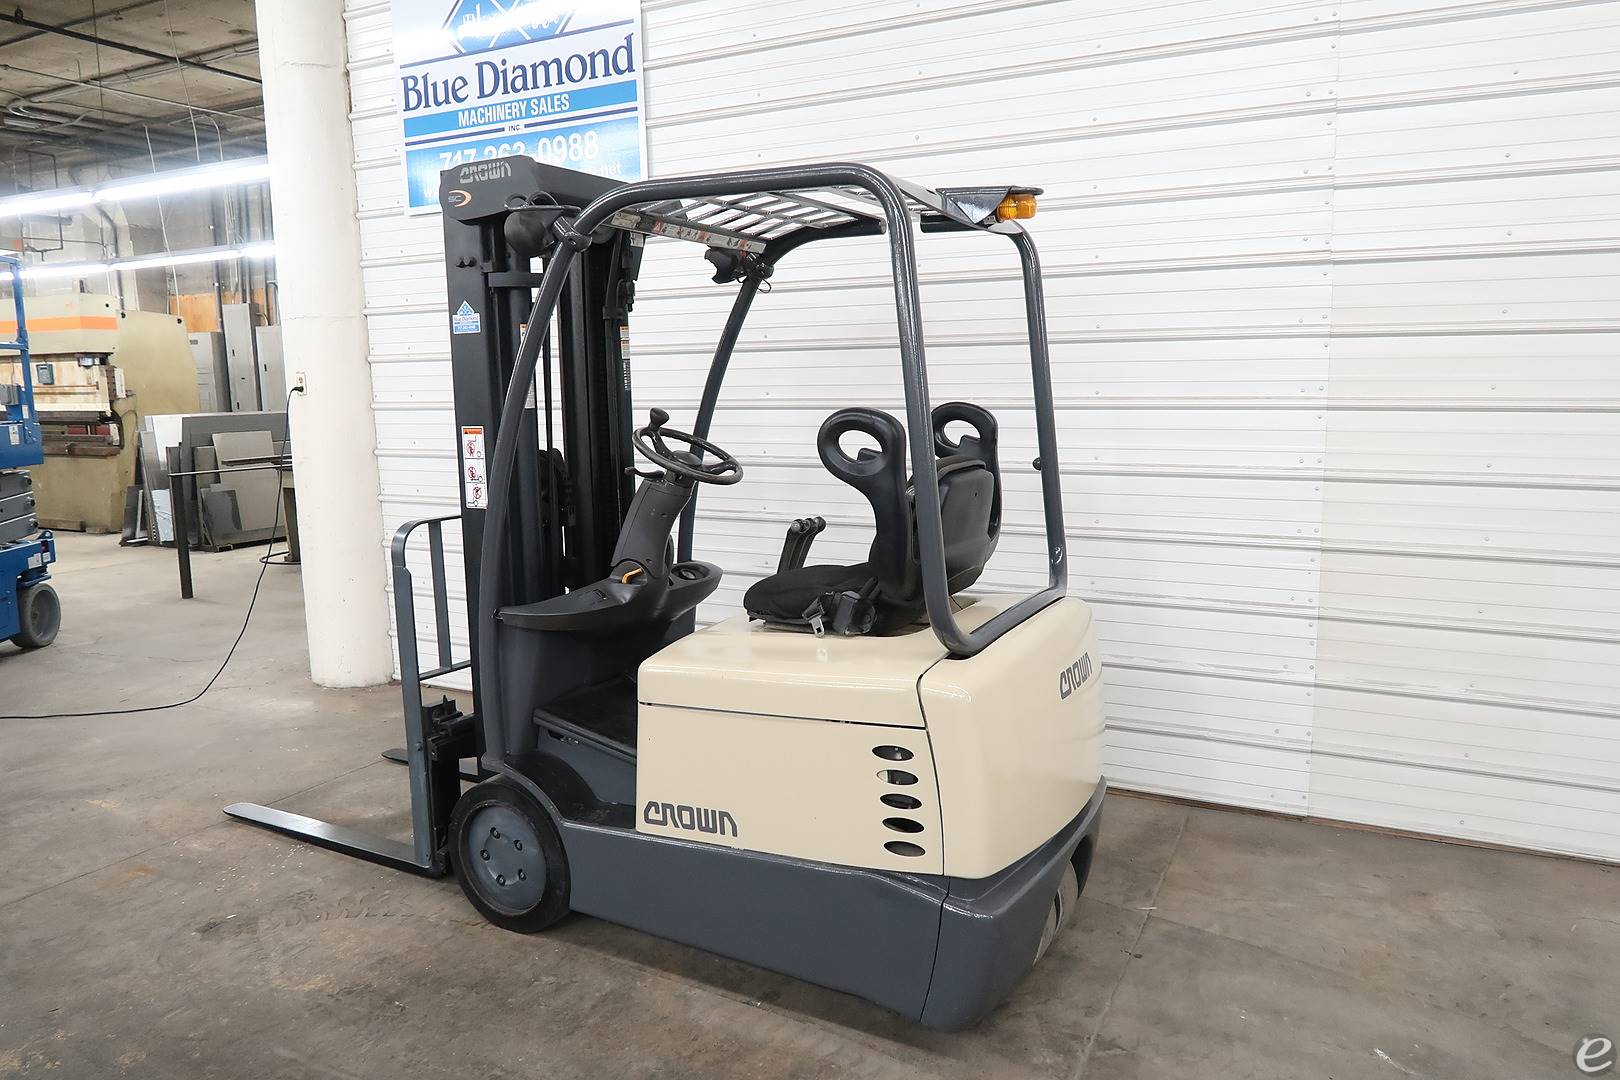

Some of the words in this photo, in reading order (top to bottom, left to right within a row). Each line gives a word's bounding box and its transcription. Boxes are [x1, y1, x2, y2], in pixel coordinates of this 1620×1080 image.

[401, 72, 469, 112] Blue
[475, 32, 636, 99] Diamond
[458, 100, 527, 127] MACHINERY
[530, 93, 570, 116] SALES
[508, 124, 523, 132] INC.
[459, 161, 512, 184] CROWN
[1059, 651, 1093, 700] CROWN
[643, 800, 738, 838] CROWN
